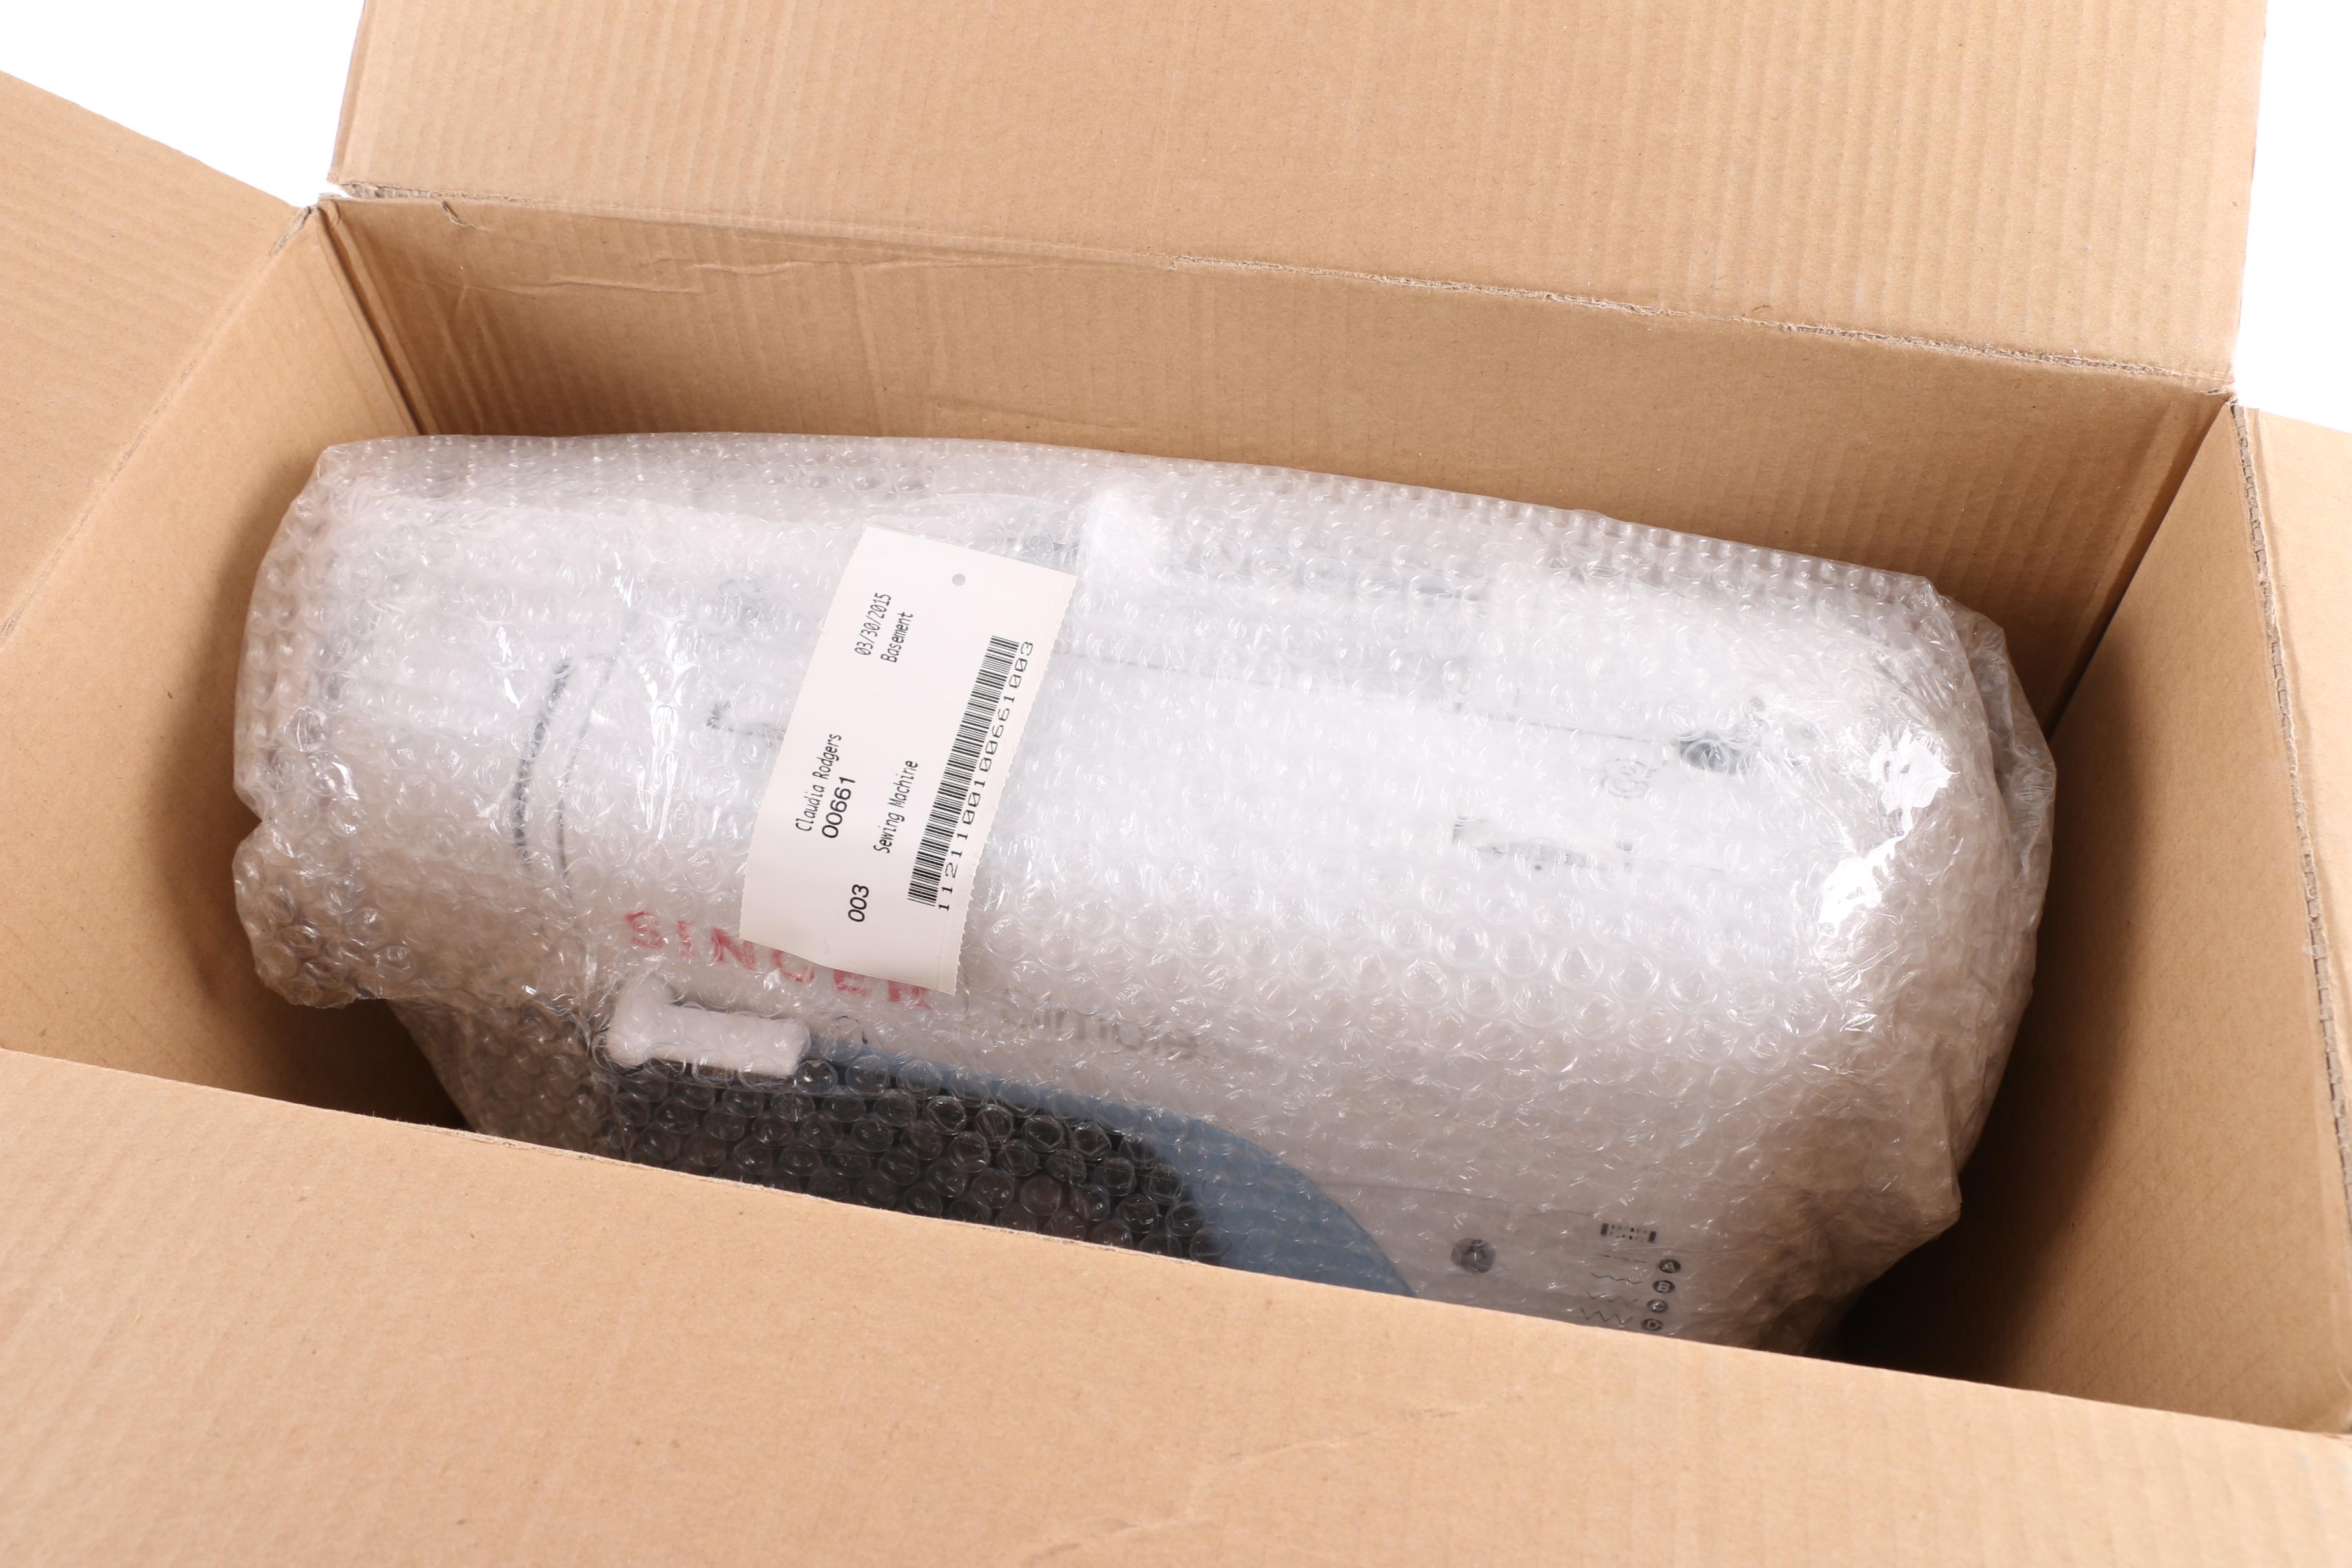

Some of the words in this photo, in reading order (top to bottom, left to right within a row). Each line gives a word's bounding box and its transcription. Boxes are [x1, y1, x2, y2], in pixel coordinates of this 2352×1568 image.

[854, 593, 892, 656] 03/30/2015
[880, 612, 914, 663] Basement
[795, 784, 825, 832] Claudia
[812, 733, 842, 779] Rodgers
[887, 760, 919, 808] Machine
[938, 642, 1034, 912] 1121100100661003
[821, 776, 856, 839] 00661
[873, 811, 905, 854] Sewing
[847, 884, 870, 923] 003
